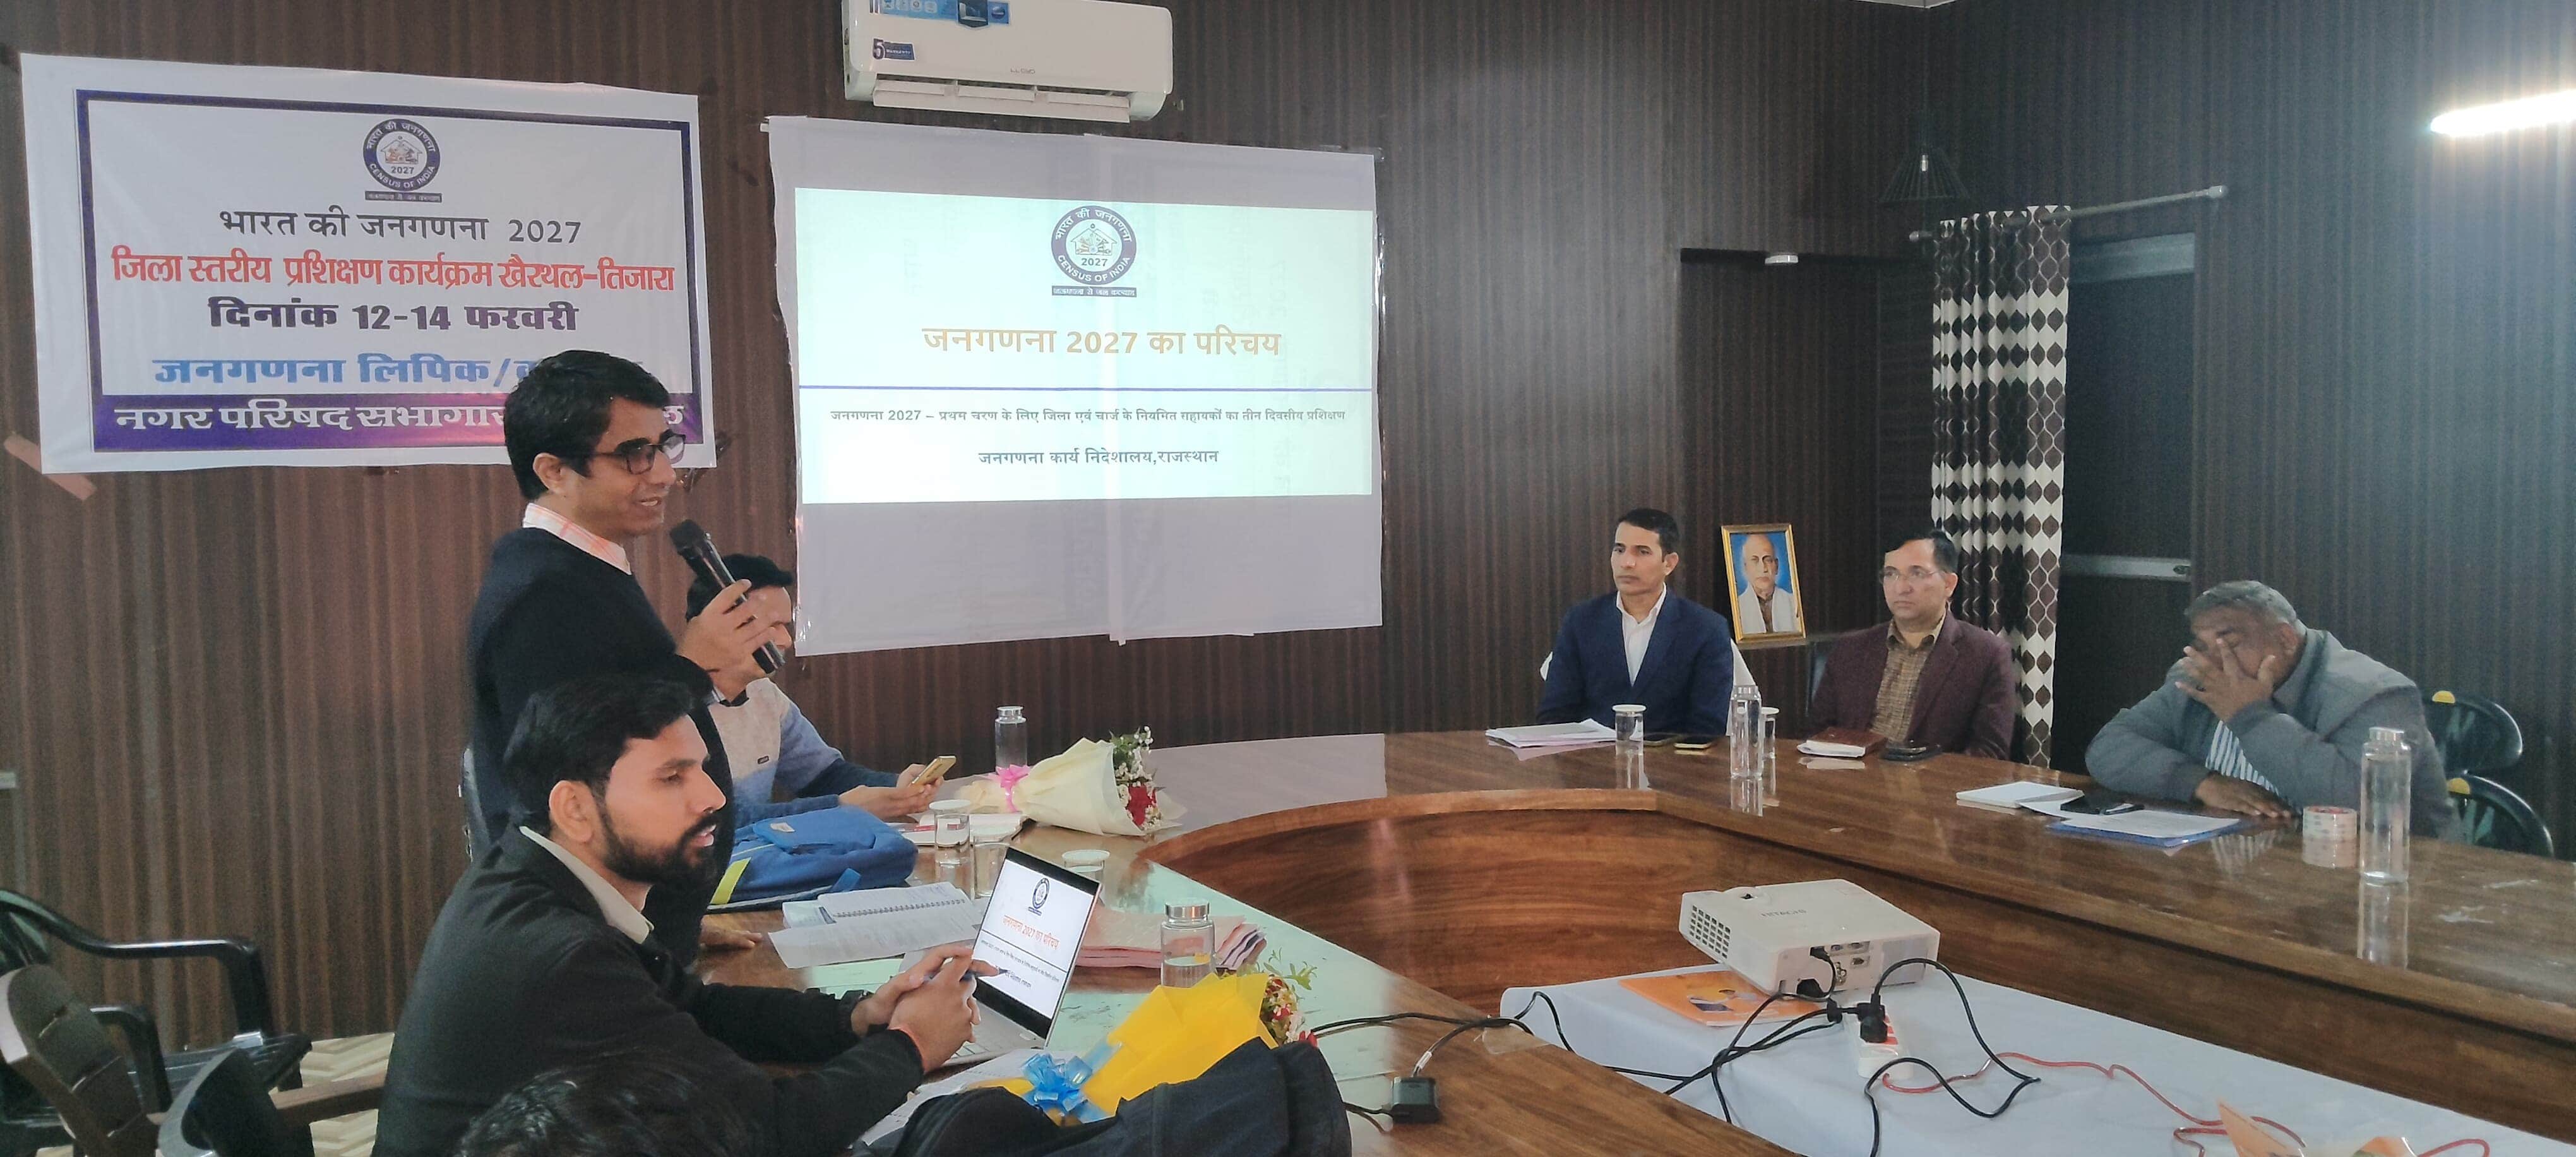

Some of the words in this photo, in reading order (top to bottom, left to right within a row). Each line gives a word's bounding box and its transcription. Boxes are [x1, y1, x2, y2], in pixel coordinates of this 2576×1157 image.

[369, 163, 401, 188] CENSUS
[417, 165, 436, 184] INDIA
[391, 166, 415, 174] 2027
[220, 210, 298, 236] भारत
[304, 205, 350, 237] की
[355, 214, 489, 241] जनगणना
[509, 219, 581, 244] 2027
[1055, 215, 1074, 239] भारत
[1076, 208, 1091, 218] की
[1095, 210, 1132, 242] जनगणना
[111, 244, 183, 282] जिला
[188, 248, 272, 284] स्तरीय
[283, 249, 383, 286] प्रशिक्षण
[387, 252, 493, 289] कार्यक्रम
[1058, 255, 1092, 282] CENSUS
[1109, 258, 1130, 278] INDIA
[208, 296, 339, 328] दिनांक
[352, 305, 451, 330] 12-14
[464, 301, 579, 330] फरवरी
[921, 328, 1058, 353] जनगणना
[1067, 331, 1138, 354] 2027
[1147, 332, 1186, 354] का
[1193, 324, 1281, 356] परिचय
[152, 359, 347, 383] जनगणना
[114, 408, 213, 429] नगर
[218, 399, 352, 430] परिषद
[831, 411, 884, 421] जनगणना
[888, 411, 921, 421] 2027
[939, 411, 967, 421] प्रथम
[971, 411, 998, 421] चरण
[1002, 408, 1012, 421] के
[1016, 409, 1039, 423] लिए
[1043, 409, 1071, 421] जिला
[1075, 409, 1092, 423] एवं
[1095, 409, 1119, 421] चार्ज
[1123, 408, 1133, 421] के
[1136, 409, 1177, 421] नियमित
[1181, 409, 1222, 423] सहायकों
[1225, 411, 1238, 421] का
[1243, 408, 1261, 421] तीन
[1265, 408, 1304, 421] दिवसीय
[1307, 408, 1345, 421] प्रशिक्षण
[979, 453, 1044, 465] जनगणना
[1049, 447, 1080, 464] कार्य
